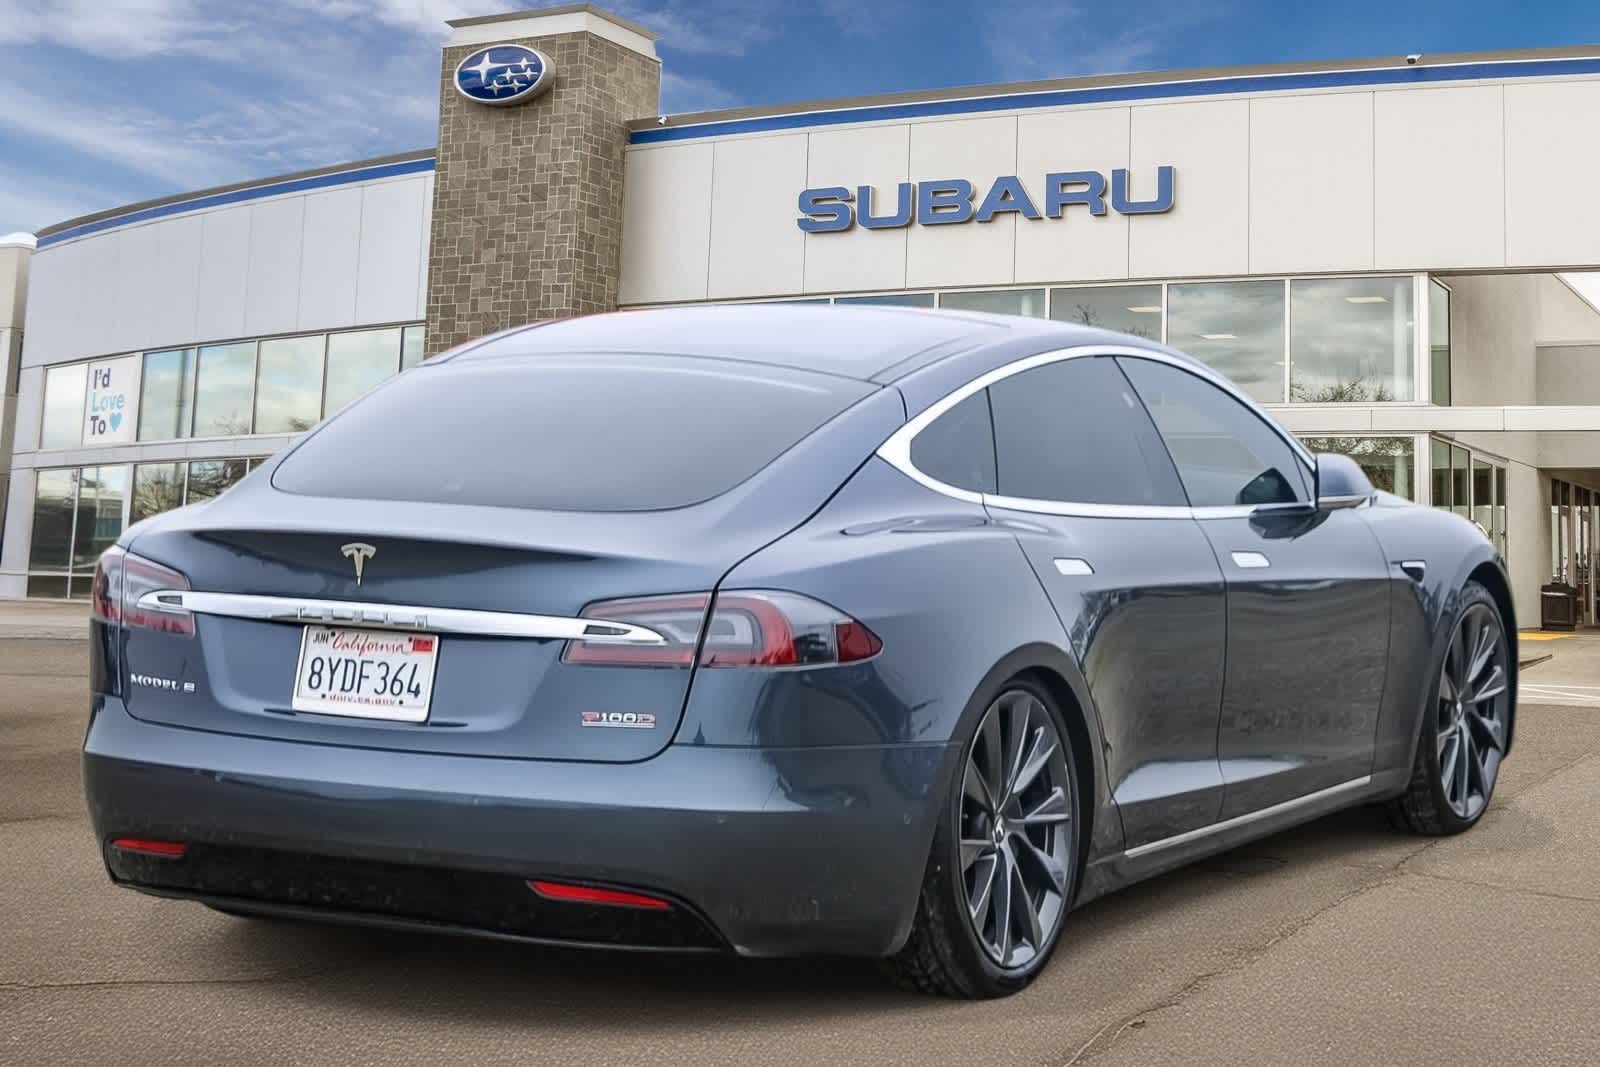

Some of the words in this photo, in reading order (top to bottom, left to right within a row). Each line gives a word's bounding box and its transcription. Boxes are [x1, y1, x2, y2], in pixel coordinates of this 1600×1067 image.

[797, 165, 1176, 233] SUBARU
[93, 367, 111, 390] I'd
[91, 391, 125, 412] Love
[90, 415, 106, 435] To
[332, 631, 409, 656] California
[130, 673, 180, 691] MODEL
[308, 656, 421, 699] 8YDF364
